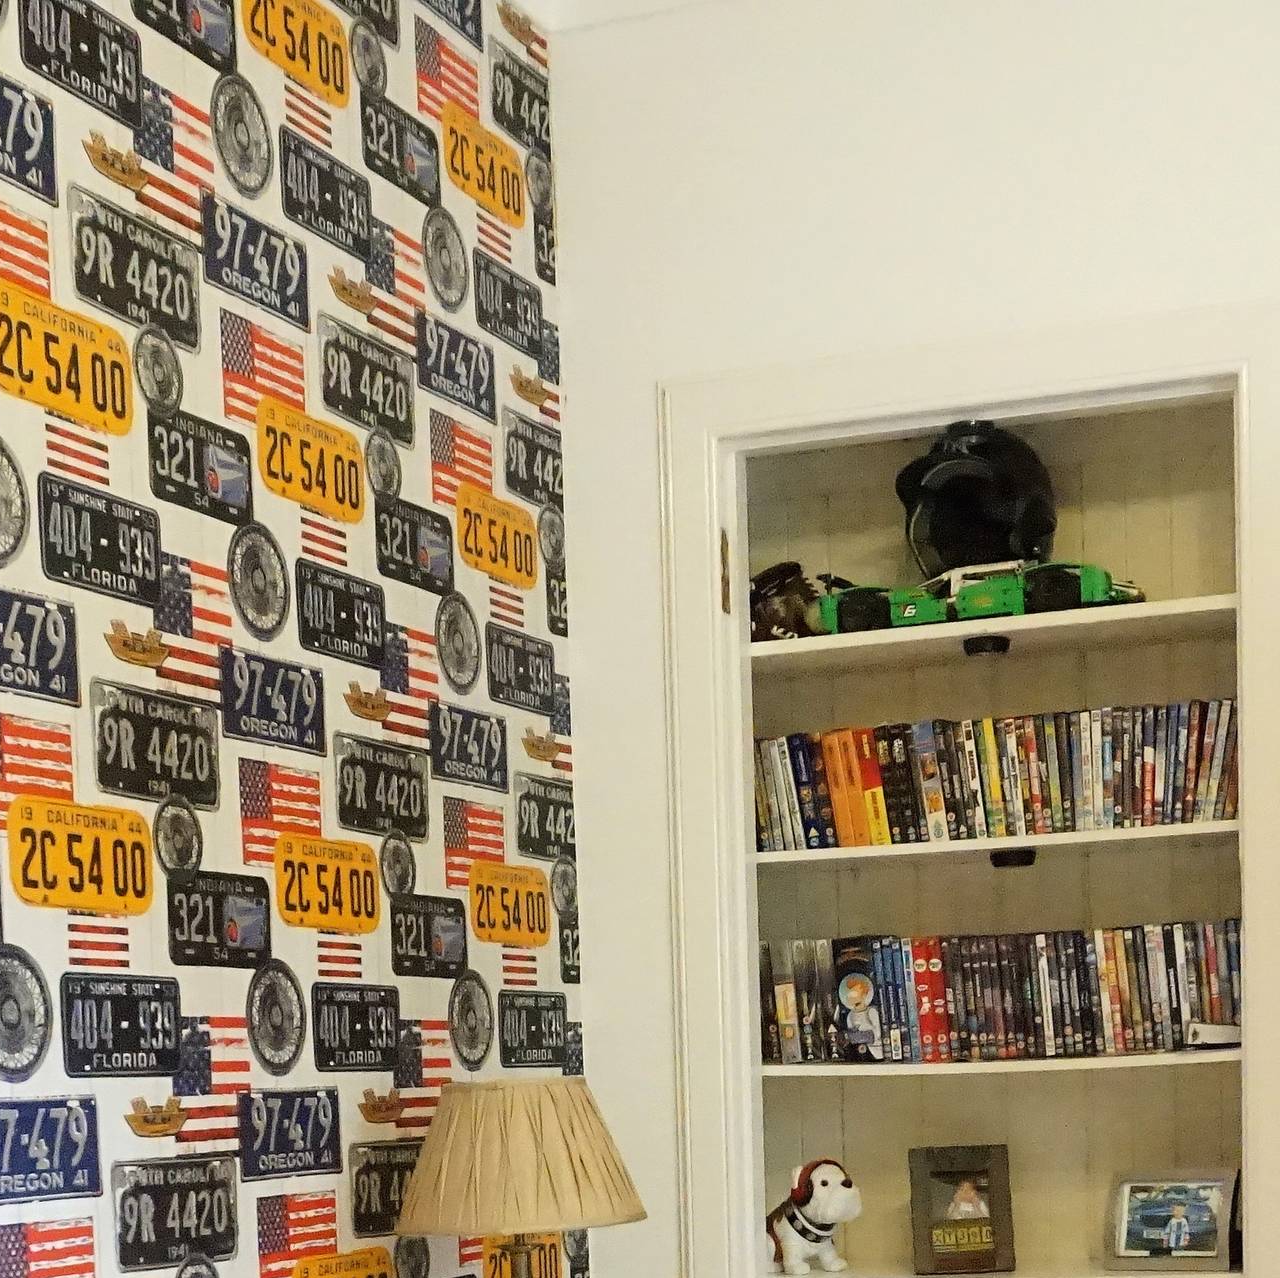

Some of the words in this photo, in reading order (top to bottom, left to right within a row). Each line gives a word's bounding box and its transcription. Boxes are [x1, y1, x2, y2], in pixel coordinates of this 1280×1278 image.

[80, 227, 113, 288] 9R
[126, 247, 190, 321] 4420
[223, 267, 282, 308] OREGON
[45, 331, 85, 401] 54
[91, 352, 128, 422] 00
[266, 432, 292, 485] 2C
[300, 441, 326, 497] 54
[331, 456, 359, 510] 00
